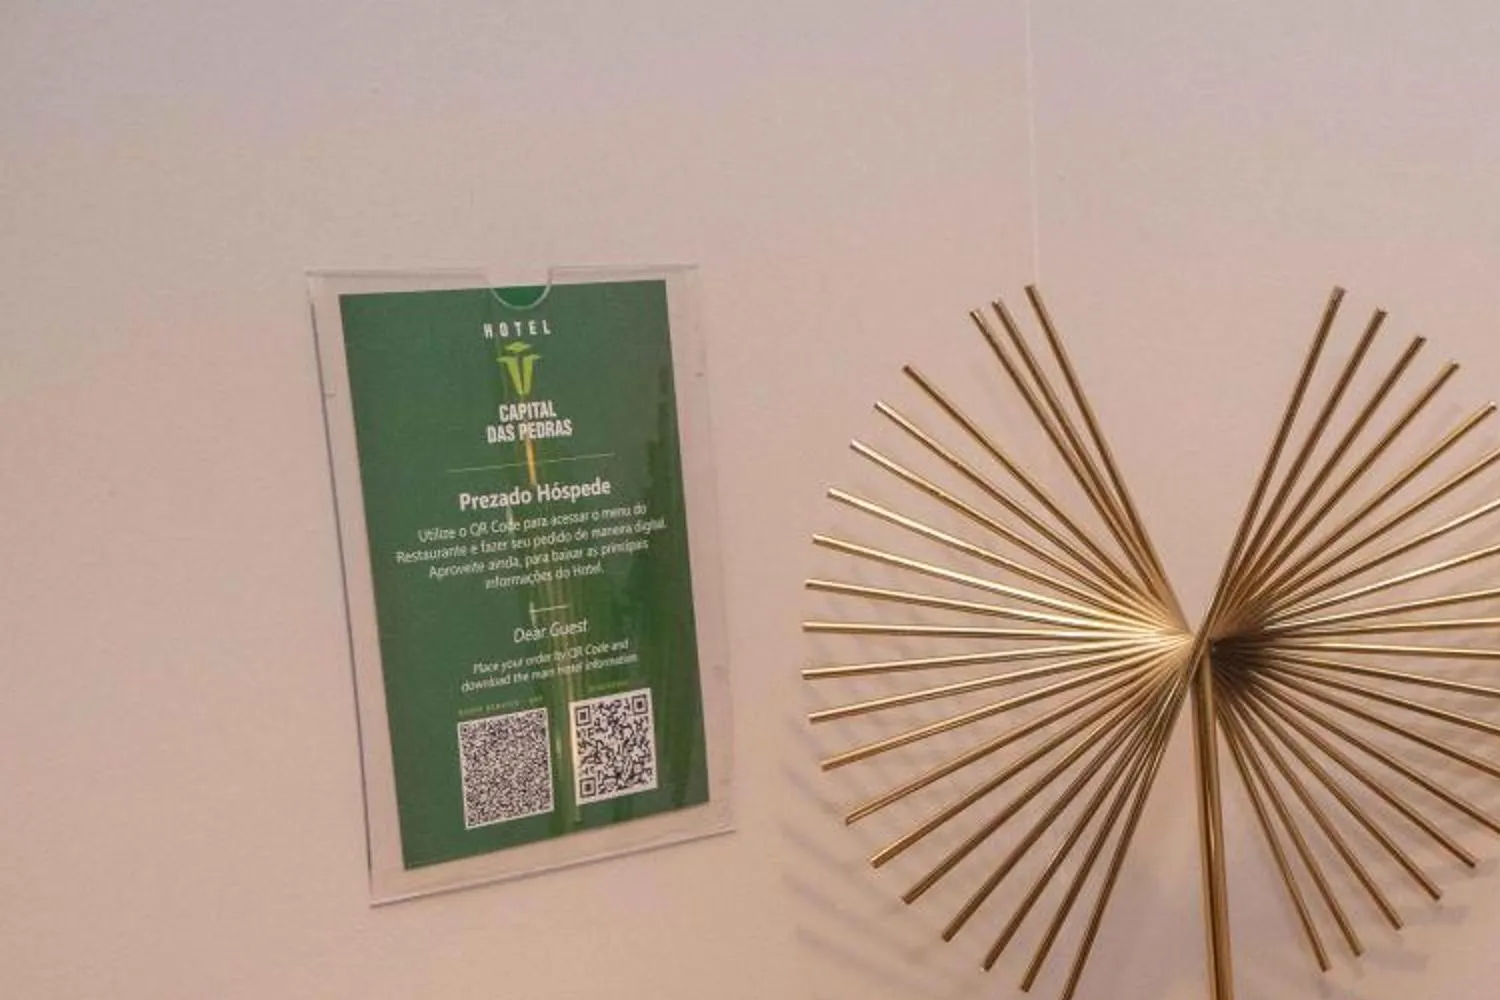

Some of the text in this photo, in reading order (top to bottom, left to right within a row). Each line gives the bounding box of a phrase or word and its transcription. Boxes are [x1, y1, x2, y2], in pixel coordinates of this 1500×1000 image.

[483, 319, 552, 338] HOTEL
[499, 400, 556, 422] CAPITAL
[486, 419, 573, 444] DAS PEDRAS
[459, 477, 611, 511] Prezado Hóspede
[417, 503, 647, 543] Utilize o QR Code para acessar o menu do
[396, 544, 468, 563] Restaurante
[533, 530, 573, 549] pedido
[574, 528, 588, 541] de
[591, 524, 633, 538] maneira
[524, 551, 549, 569] para
[551, 547, 583, 562] baixar
[555, 566, 571, 580] do
[513, 617, 588, 644] Dear Guest
[473, 658, 500, 675] Place
[500, 656, 523, 674] your
[585, 641, 610, 656] Code
[460, 675, 512, 694] download
